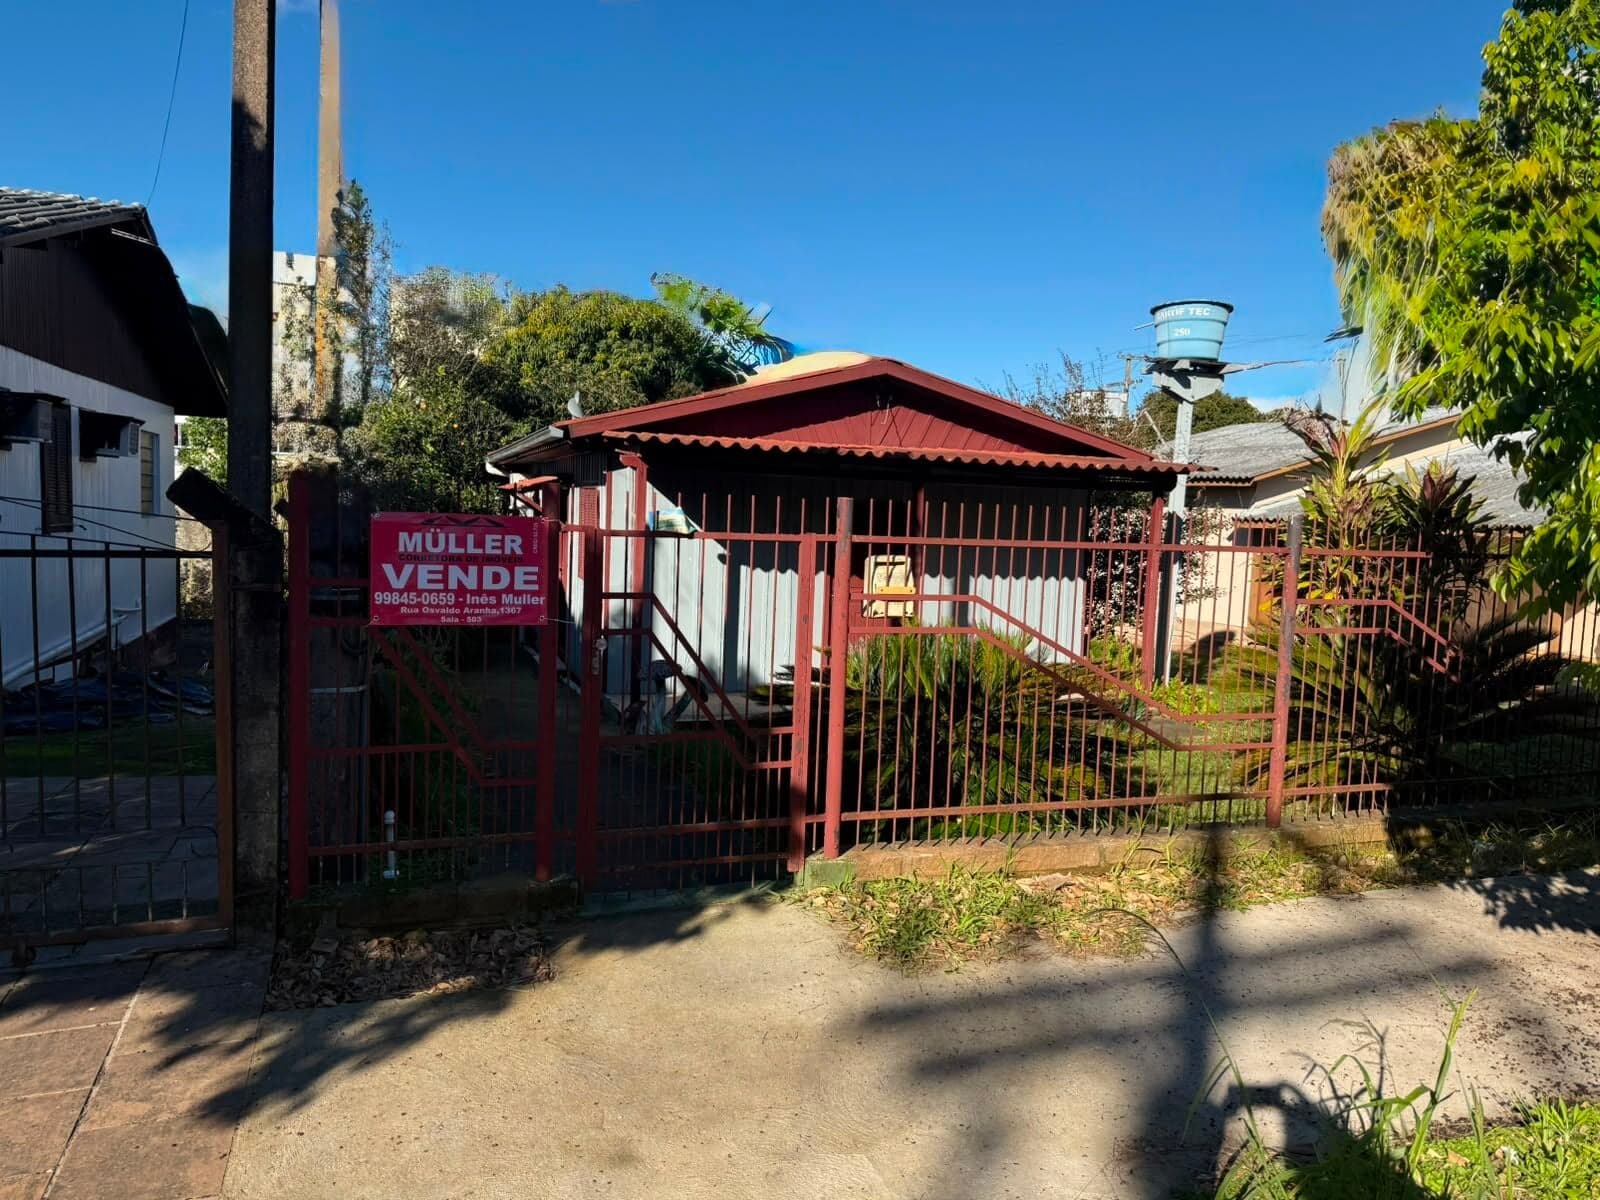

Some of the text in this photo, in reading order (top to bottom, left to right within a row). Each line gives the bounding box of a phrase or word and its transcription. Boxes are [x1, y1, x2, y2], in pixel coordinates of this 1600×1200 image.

[1188, 307, 1211, 316] TEC
[1174, 328, 1190, 336] 250
[398, 528, 523, 555] MÜLLER
[382, 563, 539, 590] VENDE
[374, 592, 455, 605] 99845-0659
[466, 593, 497, 605] Inês
[501, 593, 546, 606] Muller
[400, 606, 419, 614] Rua
[422, 606, 461, 614] Osvaldo
